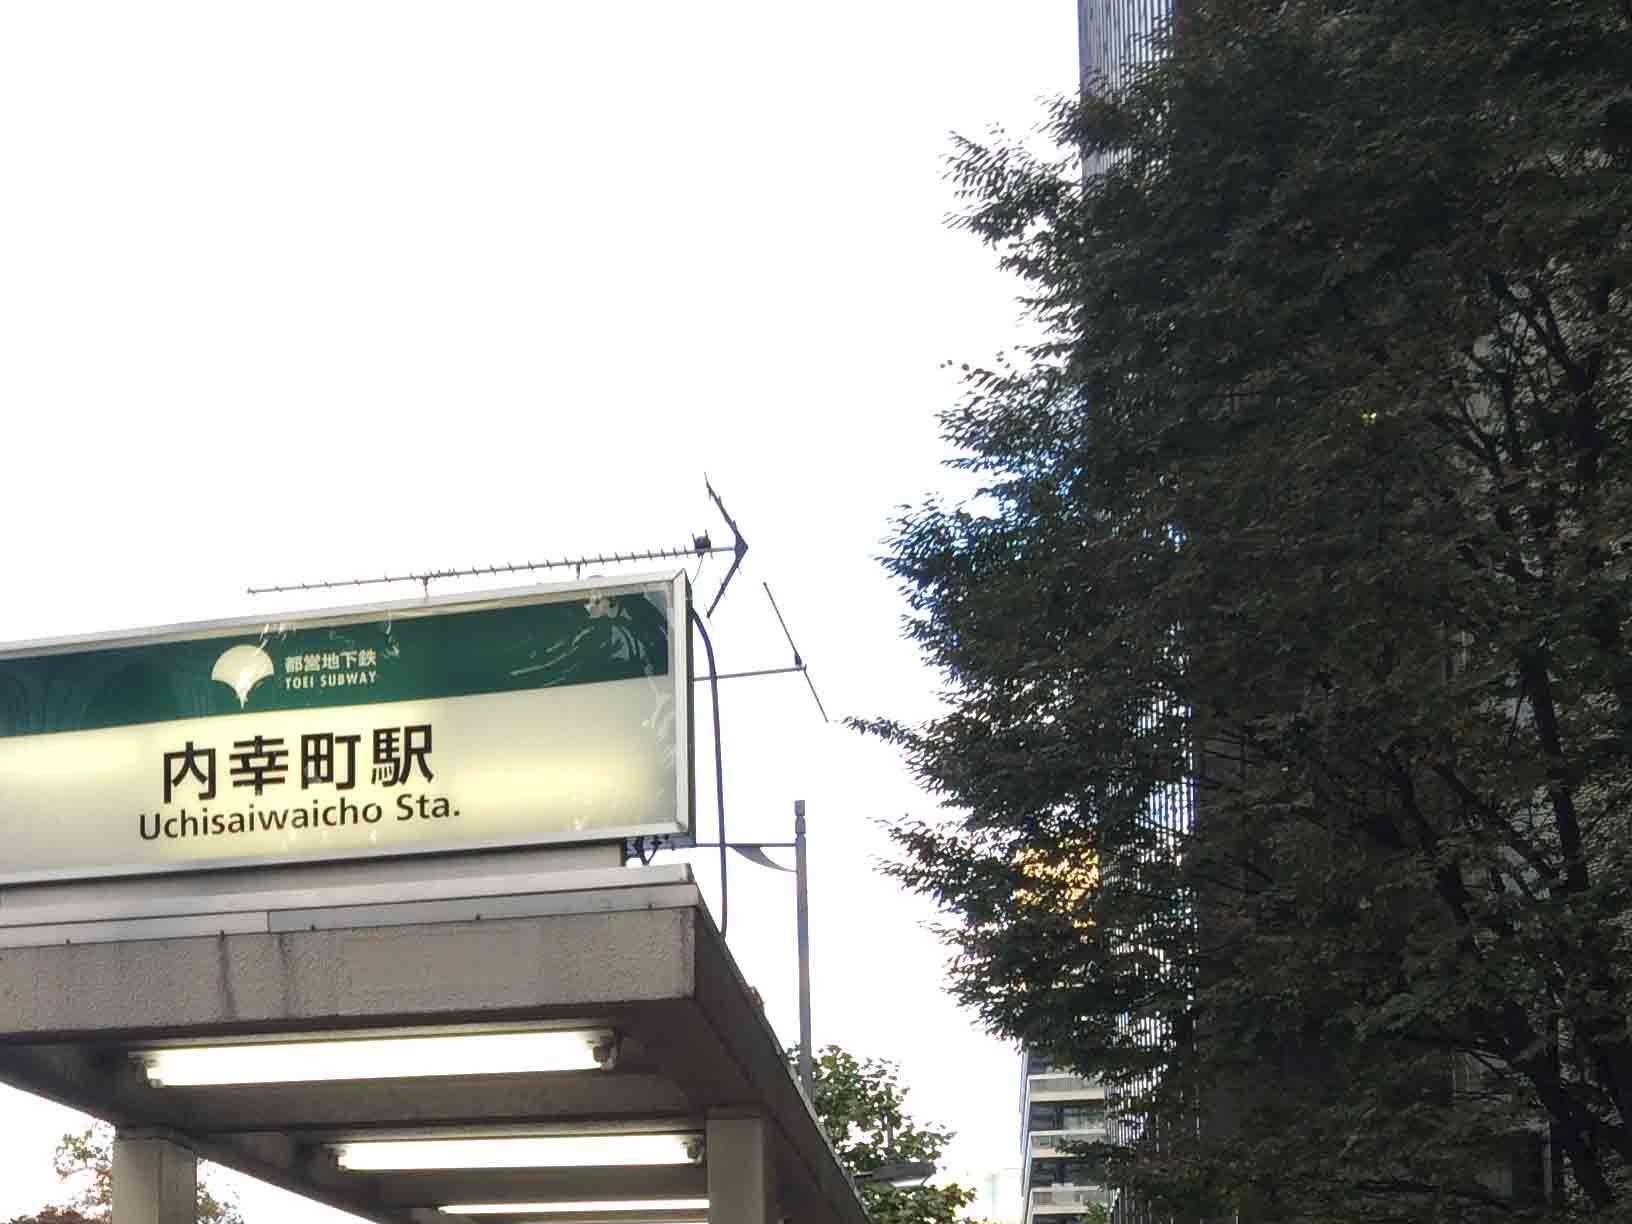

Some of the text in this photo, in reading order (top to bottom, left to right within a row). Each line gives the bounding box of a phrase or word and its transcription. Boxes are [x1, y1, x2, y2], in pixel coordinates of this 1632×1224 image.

[284, 648, 377, 672] 都営地下鉄
[285, 670, 377, 690] TOEI SUBWAY
[163, 723, 434, 803] 内幸町駅
[139, 793, 460, 841] Uchisaiwaicho Sta.
